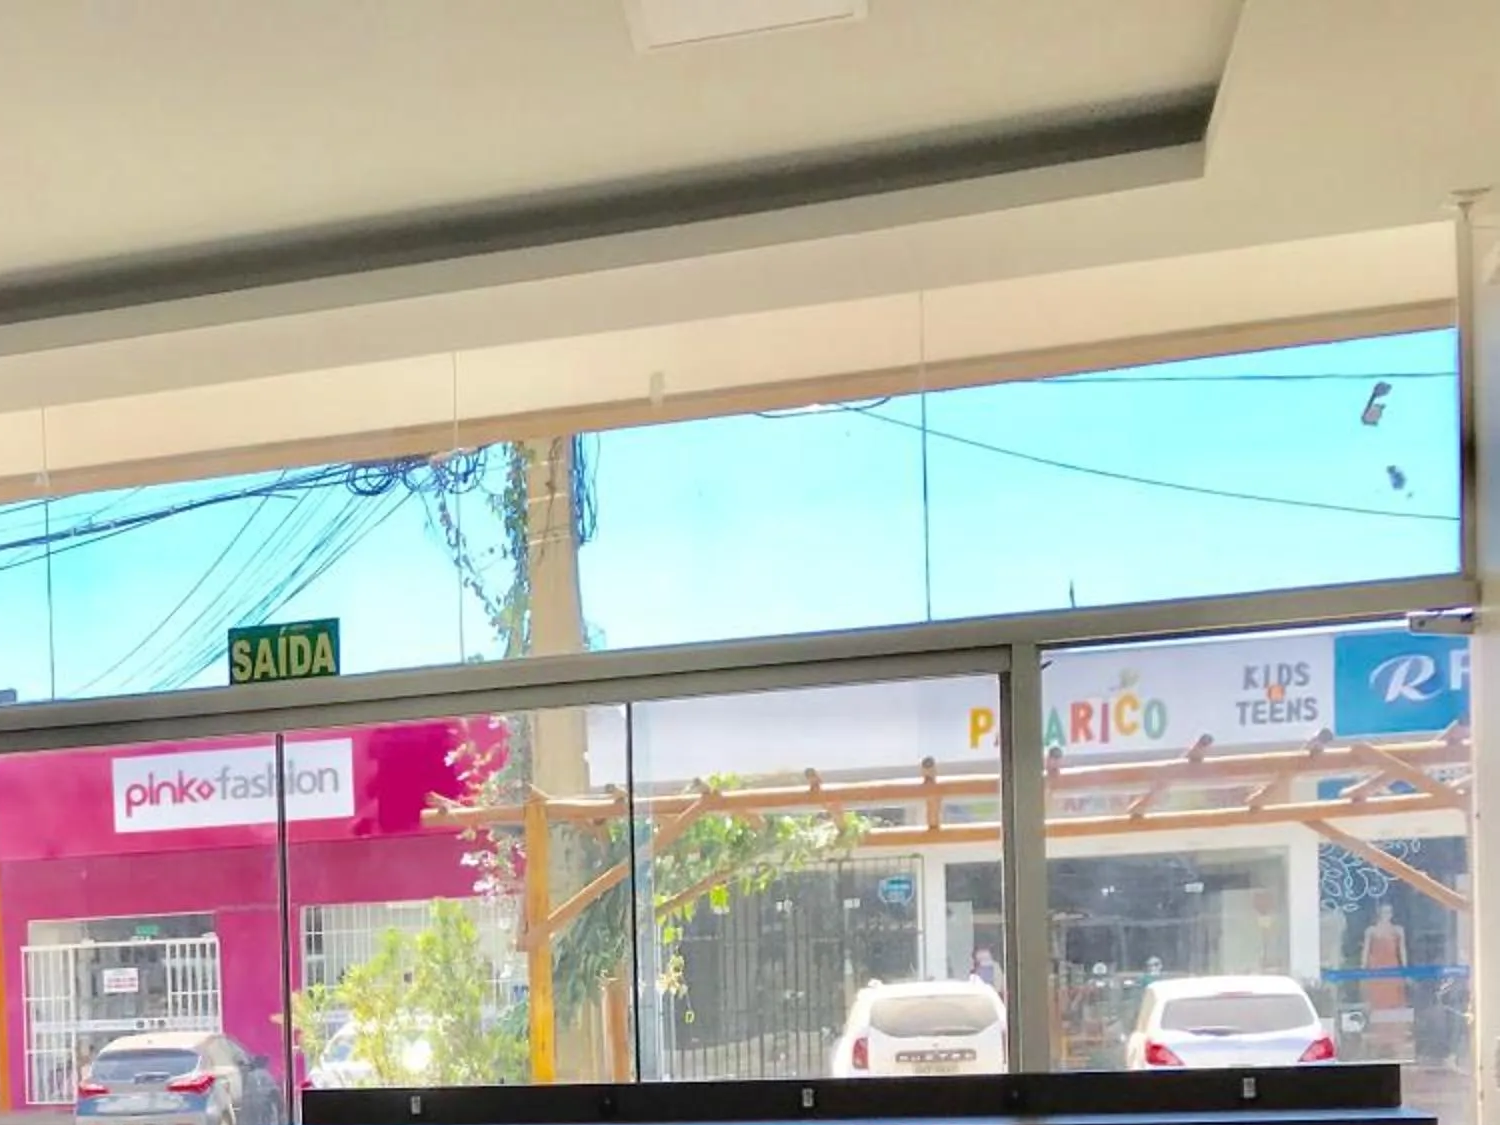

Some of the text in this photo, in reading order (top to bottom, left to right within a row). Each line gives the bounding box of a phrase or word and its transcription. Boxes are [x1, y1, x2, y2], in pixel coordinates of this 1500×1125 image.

[231, 626, 337, 682] SAÍDA
[1242, 661, 1311, 691] KIDS
[968, 690, 1168, 749] PARICO
[1235, 696, 1319, 726] TEENS
[124, 769, 198, 818] pink
